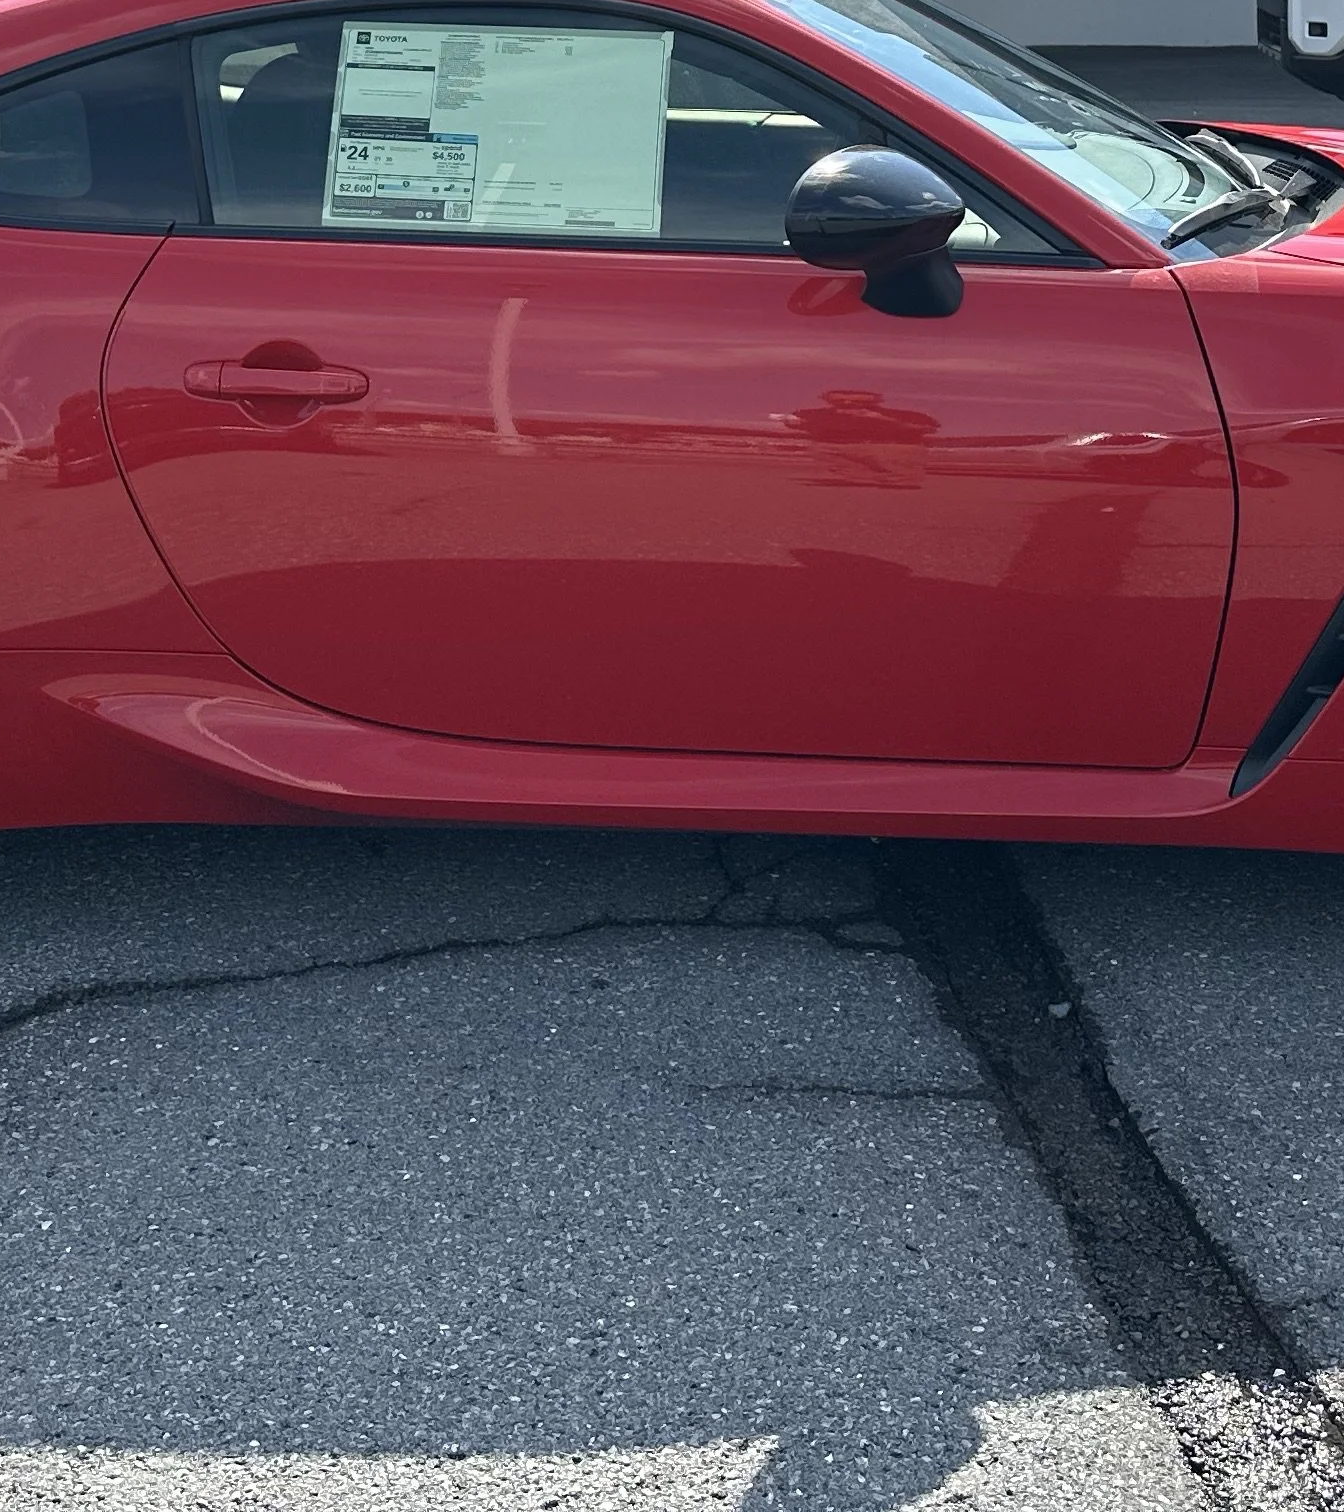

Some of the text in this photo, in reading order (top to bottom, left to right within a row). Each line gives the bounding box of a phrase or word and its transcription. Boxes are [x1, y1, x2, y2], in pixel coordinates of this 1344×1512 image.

[374, 35, 408, 43] TOYOTA
[346, 145, 369, 161] 24
[432, 151, 465, 162] $4,500
[339, 183, 372, 194] $2,600
